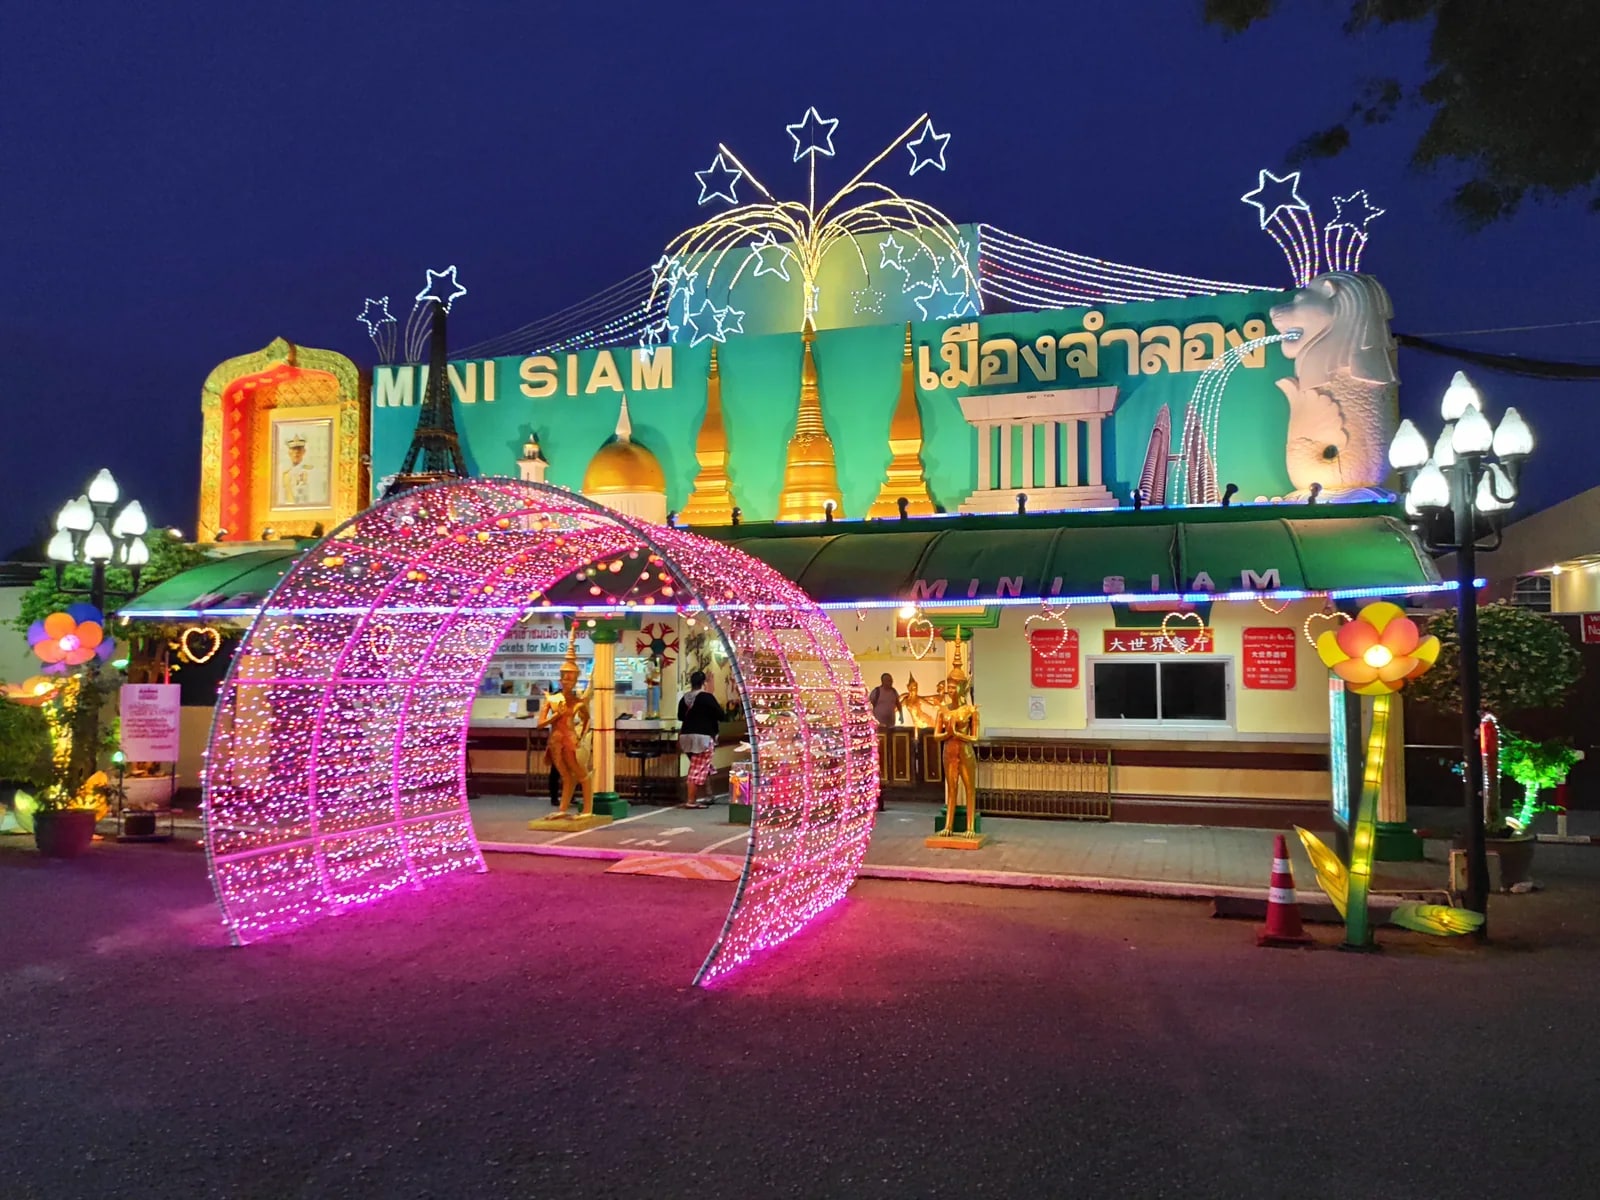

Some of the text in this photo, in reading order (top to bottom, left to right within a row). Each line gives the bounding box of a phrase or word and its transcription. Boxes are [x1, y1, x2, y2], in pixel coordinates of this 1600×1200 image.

[919, 310, 1266, 391] เมืองจำลอง
[519, 346, 673, 398] SIAM
[910, 568, 1281, 599] MINI SIAM
[499, 642, 524, 653] ickets
[526, 642, 539, 653] for
[540, 642, 557, 653] Mini
